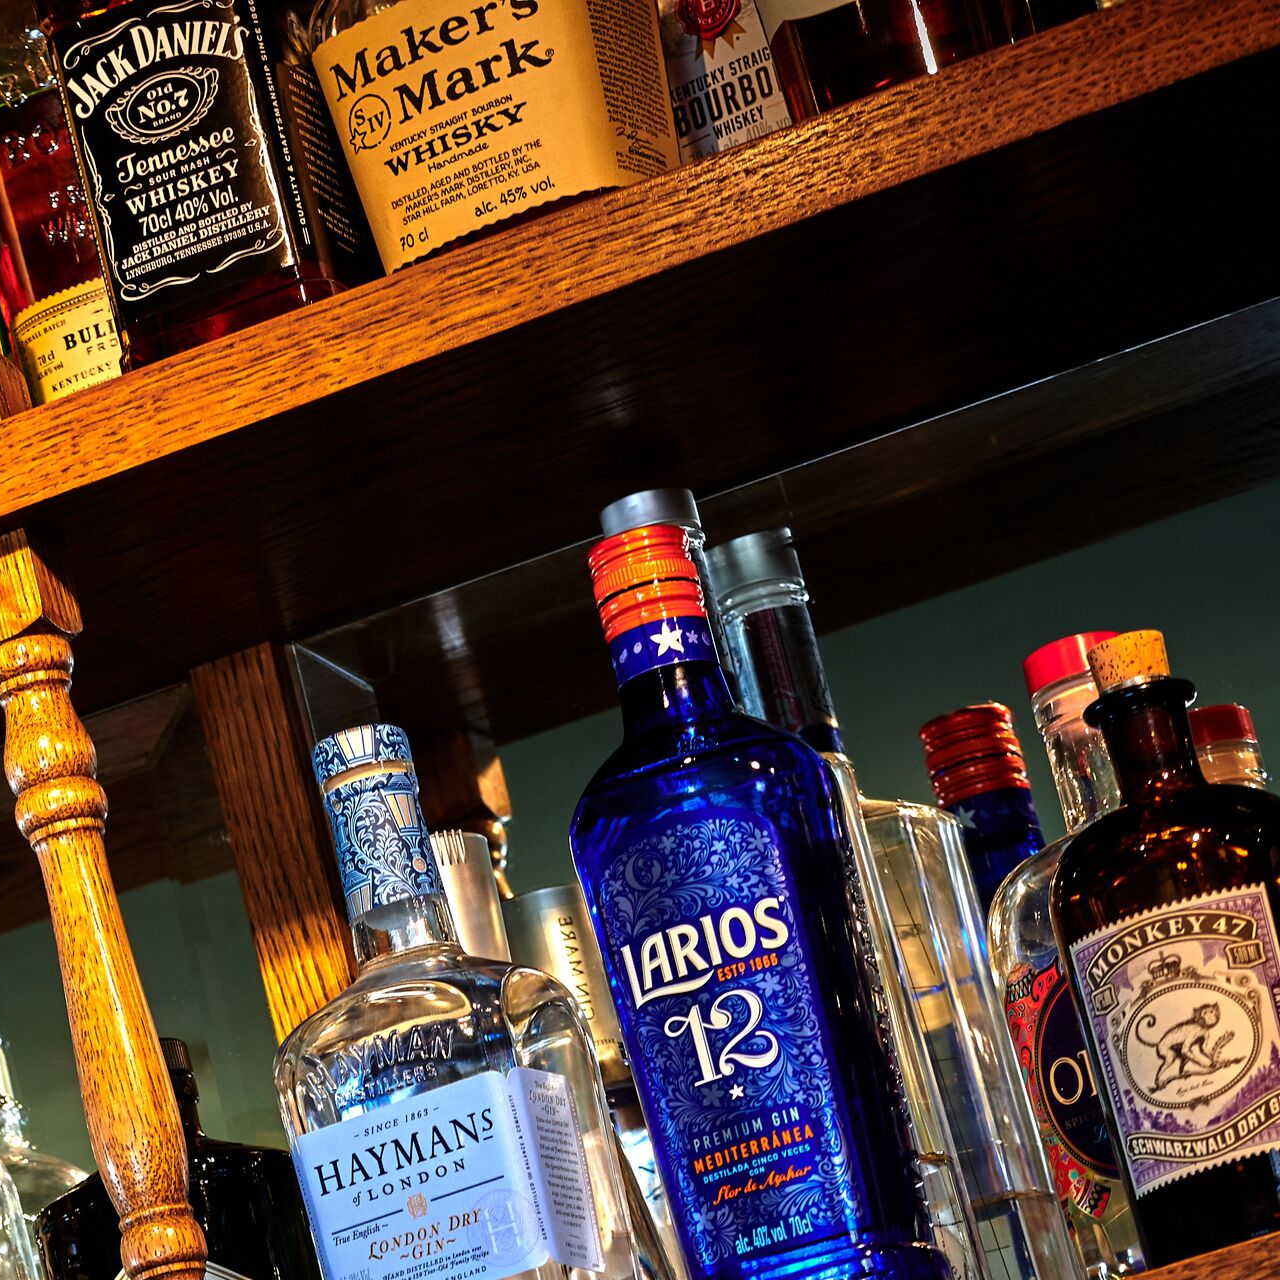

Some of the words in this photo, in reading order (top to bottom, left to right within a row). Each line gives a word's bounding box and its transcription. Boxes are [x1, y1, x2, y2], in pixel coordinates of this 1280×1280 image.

[66, 45, 137, 119] JACK
[129, 15, 250, 69] DANIEL'S
[329, 0, 540, 103] Maker's
[393, 38, 552, 125] Mark
[671, 65, 725, 104] KENTUCKY
[152, 111, 182, 128] BRAND
[384, 101, 527, 177] WHISKY
[389, 128, 428, 153] KENTUCKY
[429, 111, 468, 137] STRAIGHT
[471, 94, 513, 117] BOURBON
[712, 105, 764, 140] WHISKEY
[116, 127, 235, 184] Tennessee
[149, 168, 176, 186] SOUR
[181, 156, 210, 174] MASH
[428, 142, 490, 173] Handmade
[430, 177, 452, 195] AGED
[452, 167, 472, 184] AND
[472, 152, 510, 175] BOTTLED
[511, 147, 524, 160] BY
[524, 138, 543, 153] THE
[125, 158, 240, 216] WHISKEY
[440, 181, 466, 201] MARK
[121, 253, 152, 270] JACK
[152, 236, 198, 259] DANIEL
[199, 205, 271, 242] DISTILLERY
[132, 230, 177, 253] DISTILLED
[177, 221, 197, 237] AND
[198, 205, 239, 229] BOTTLED
[240, 201, 253, 214] BY
[139, 207, 172, 237] 70cl
[43, 320, 66, 333] BATCH
[48, 350, 55, 361] cl
[51, 361, 112, 392] KENTUCKY
[620, 897, 790, 1010] LARIOS
[750, 952, 778, 972] 1866
[1093, 916, 1207, 984] MONKEY
[1212, 919, 1247, 935] 47
[664, 989, 779, 1088] 12
[363, 1117, 400, 1139] SINCE
[404, 1107, 430, 1124] 1863
[692, 1117, 764, 1153] PREMIUM
[772, 1106, 800, 1126] GIN
[1132, 1129, 1236, 1157] SCHWARZWALD
[1237, 1111, 1266, 1140] DRY
[314, 1108, 495, 1197] HAYMANS
[693, 1124, 815, 1175] MEDITERRÁNEA
[703, 1163, 750, 1184] DESTILADA
[752, 1154, 779, 1168] CINCO
[781, 1143, 811, 1158] VECES
[749, 1166, 765, 1177] CON
[368, 1157, 468, 1202] LONDON
[713, 1184, 741, 1206] flor
[368, 1208, 443, 1261] LONDON
[448, 1207, 482, 1234] DRY
